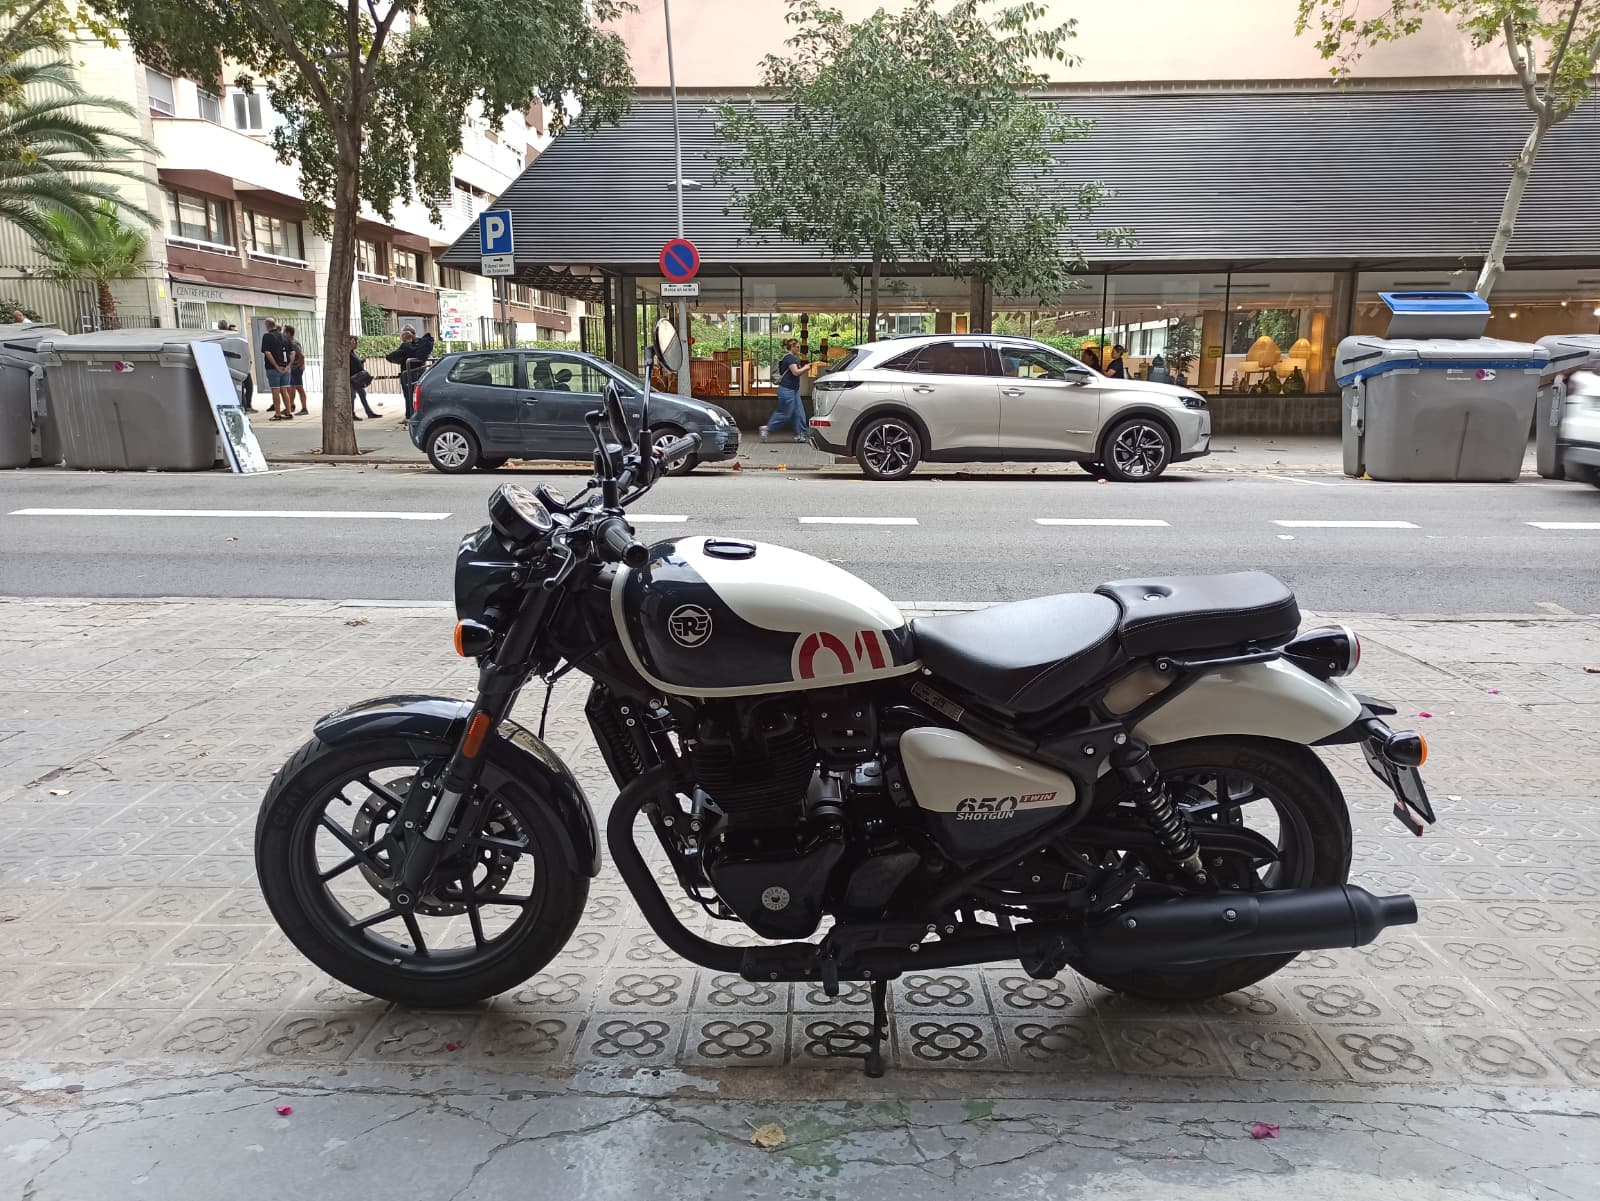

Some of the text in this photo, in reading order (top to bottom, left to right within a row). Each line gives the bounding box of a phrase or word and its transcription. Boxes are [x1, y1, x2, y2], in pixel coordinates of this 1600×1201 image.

[486, 216, 505, 250] P
[176, 286, 197, 297] CENTRE
[956, 792, 1053, 812] 650 TWIN
[955, 810, 1015, 821] SHOTGUN
